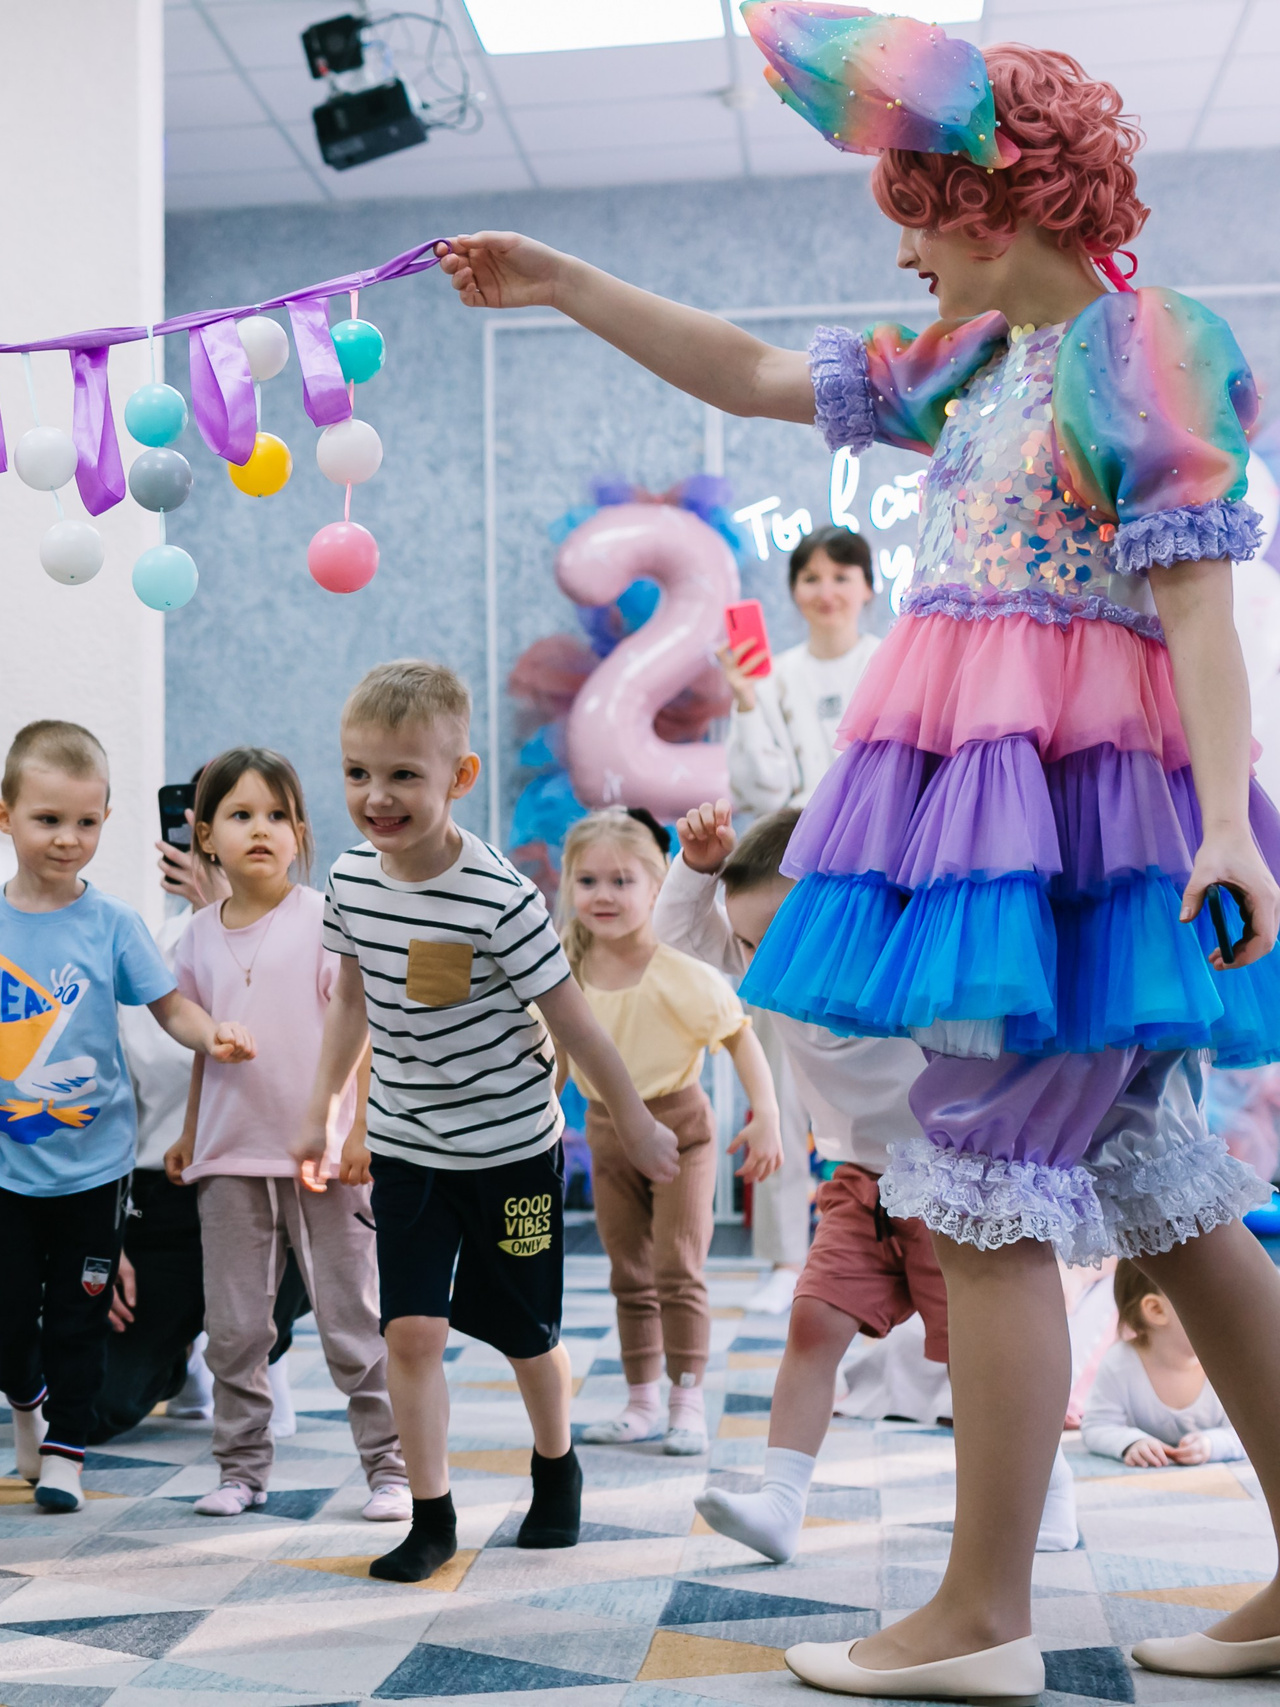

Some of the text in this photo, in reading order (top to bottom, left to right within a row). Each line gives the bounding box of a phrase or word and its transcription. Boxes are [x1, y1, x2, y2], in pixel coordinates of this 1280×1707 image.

[504, 1193, 552, 1217] GOOD
[504, 1213, 552, 1237] VIBES
[511, 1237, 543, 1253] ONLY
